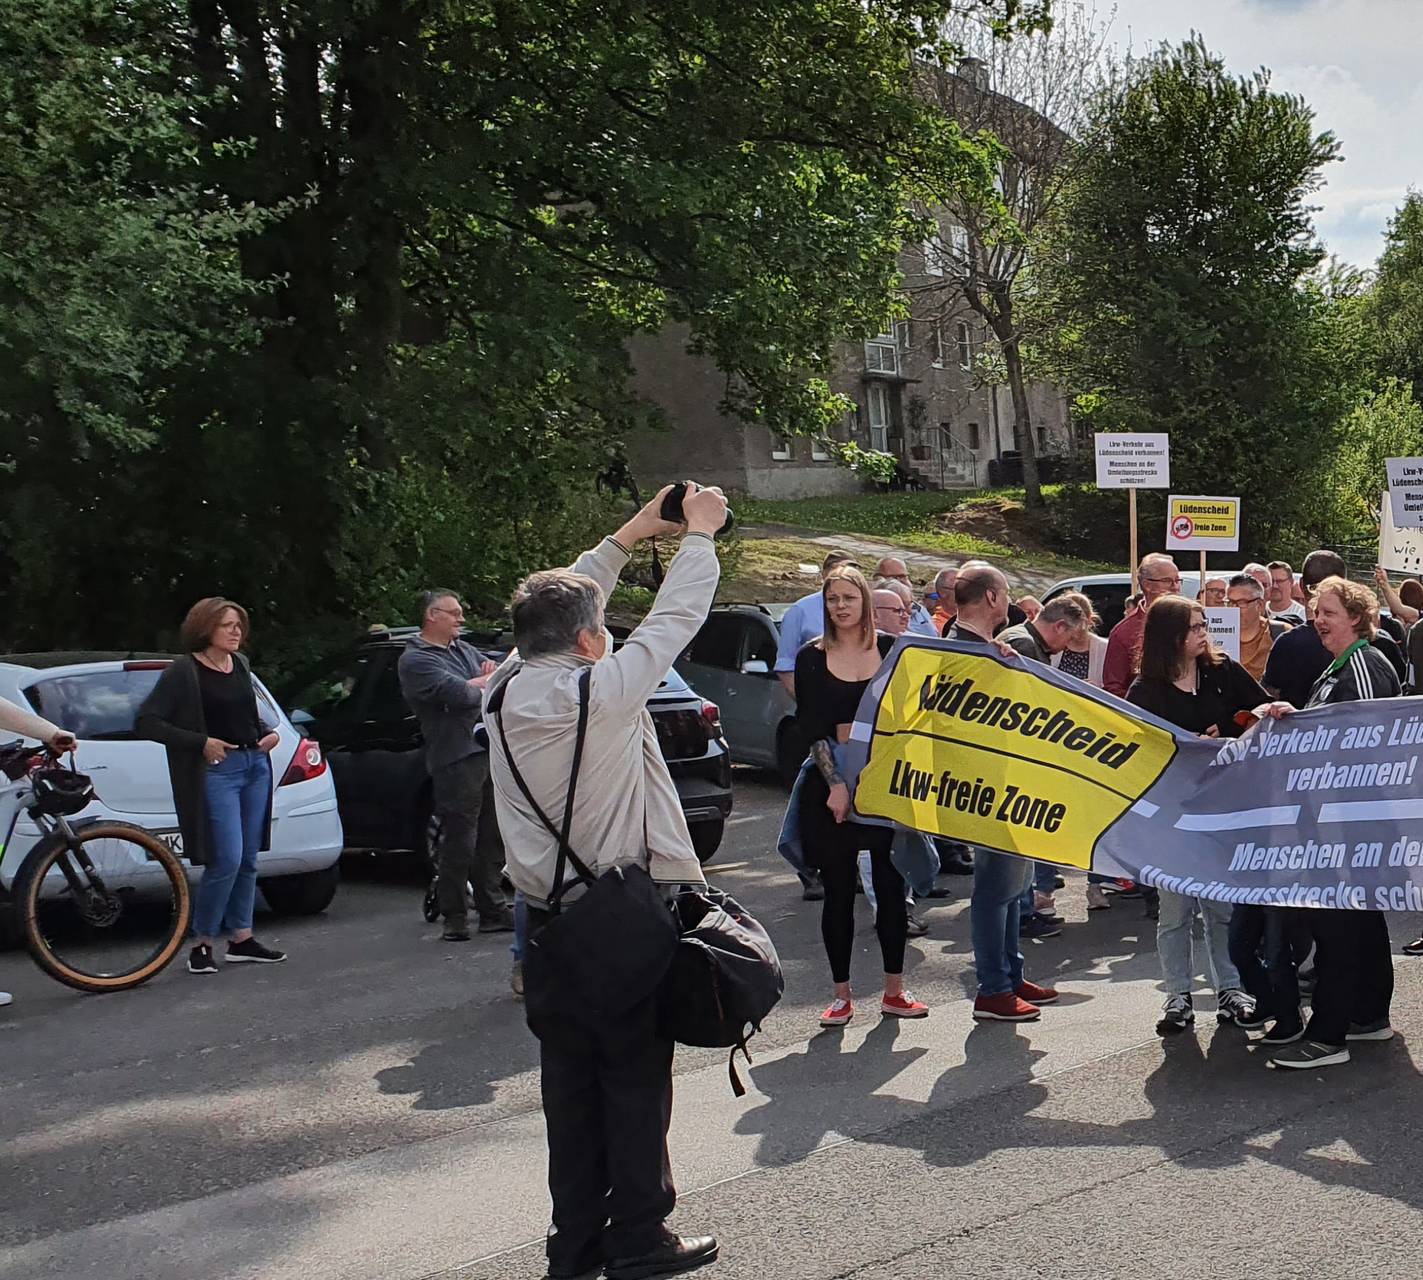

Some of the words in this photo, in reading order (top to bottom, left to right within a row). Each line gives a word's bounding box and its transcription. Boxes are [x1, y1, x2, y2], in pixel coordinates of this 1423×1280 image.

[1180, 504, 1230, 515] Lüdenscheid
[1194, 523, 1210, 532] freie
[1211, 523, 1227, 531] Zone
[1393, 541, 1417, 556] wie
[1340, 724, 1385, 750] aus
[1286, 755, 1418, 792] verbannen!
[888, 759, 997, 818] Lkw-freie
[995, 784, 1067, 834] Zone
[1228, 839, 1347, 872] Menschen
[1351, 841, 1384, 868] an
